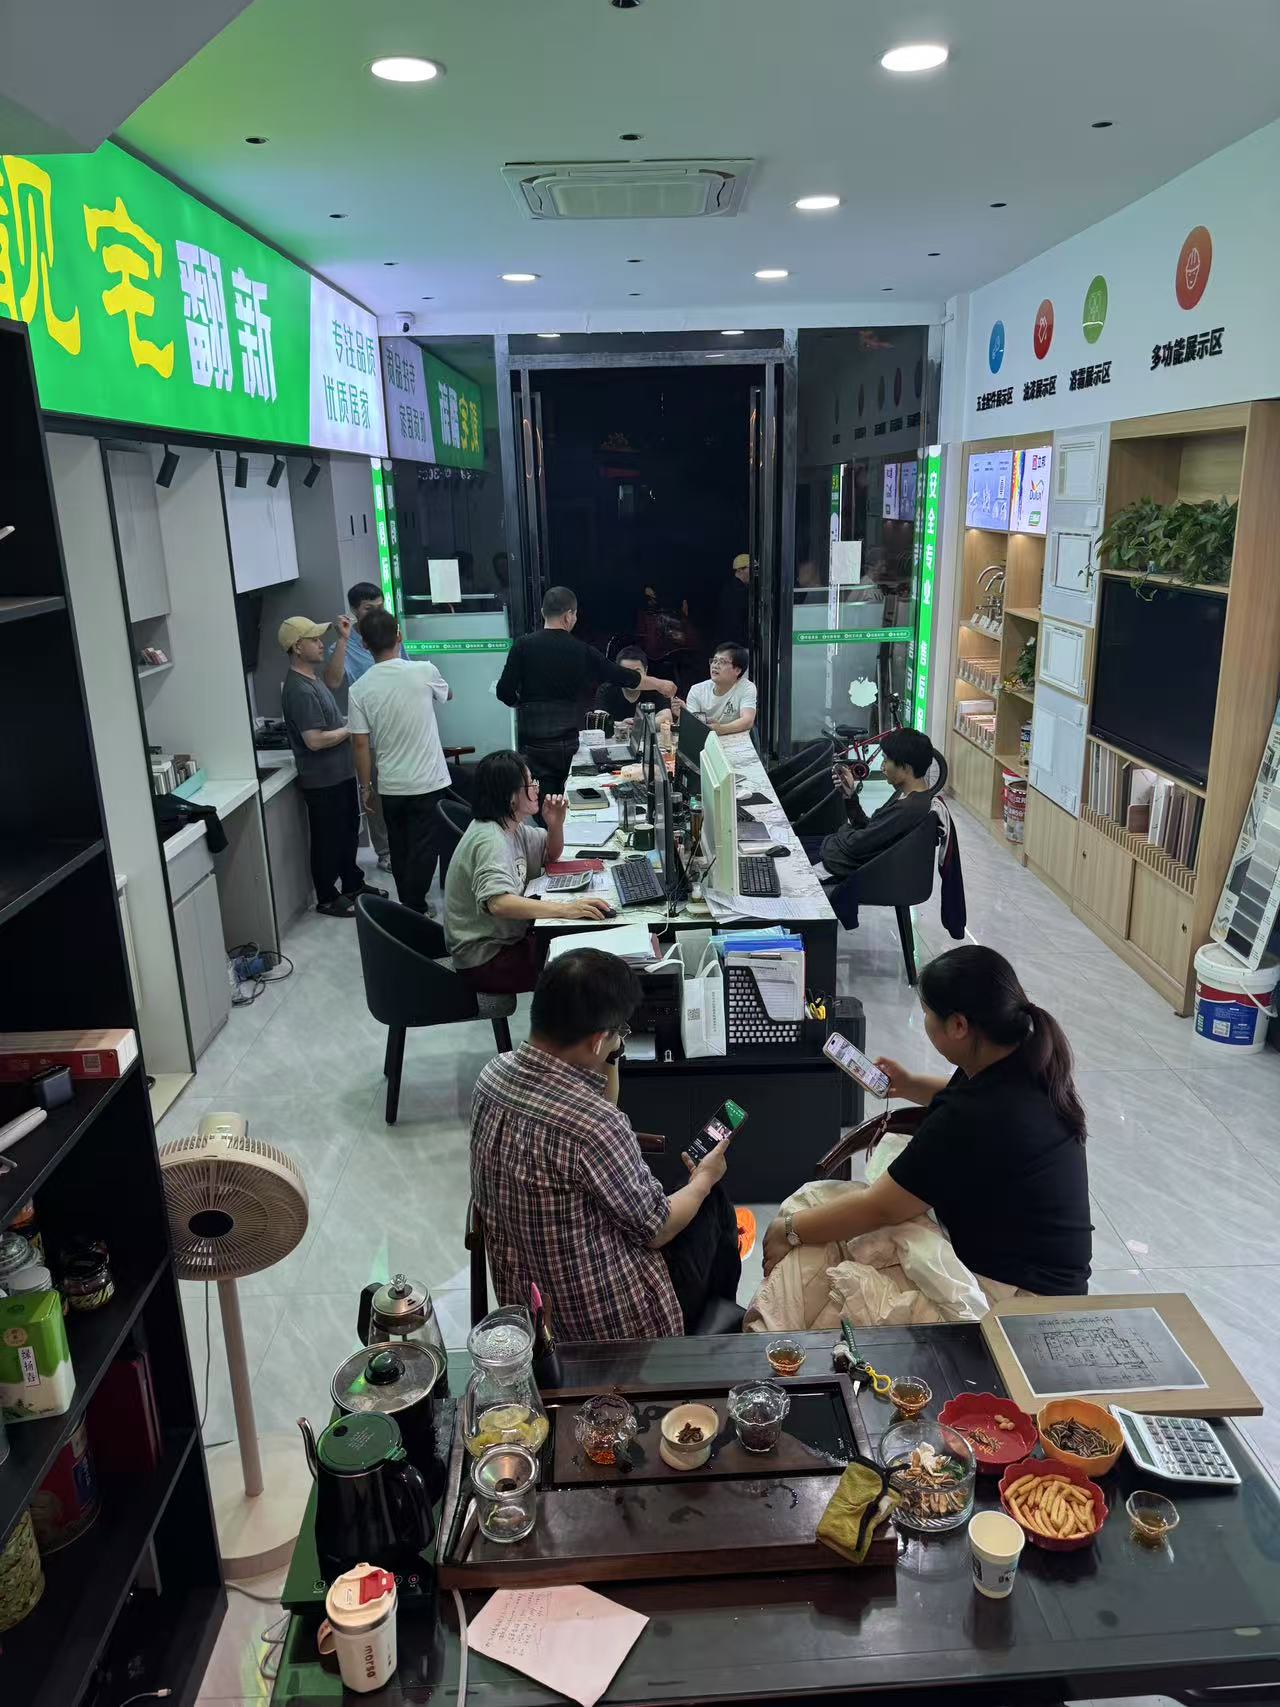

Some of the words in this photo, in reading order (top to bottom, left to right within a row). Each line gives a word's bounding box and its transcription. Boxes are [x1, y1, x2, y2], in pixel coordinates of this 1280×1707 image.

[332, 320, 376, 377] 专注品质
[1150, 327, 1225, 371] 多功能展示区
[323, 375, 370, 429] 优质居家
[976, 387, 1014, 411] 五金配件展示区
[1023, 375, 1057, 401] 油漆展示区
